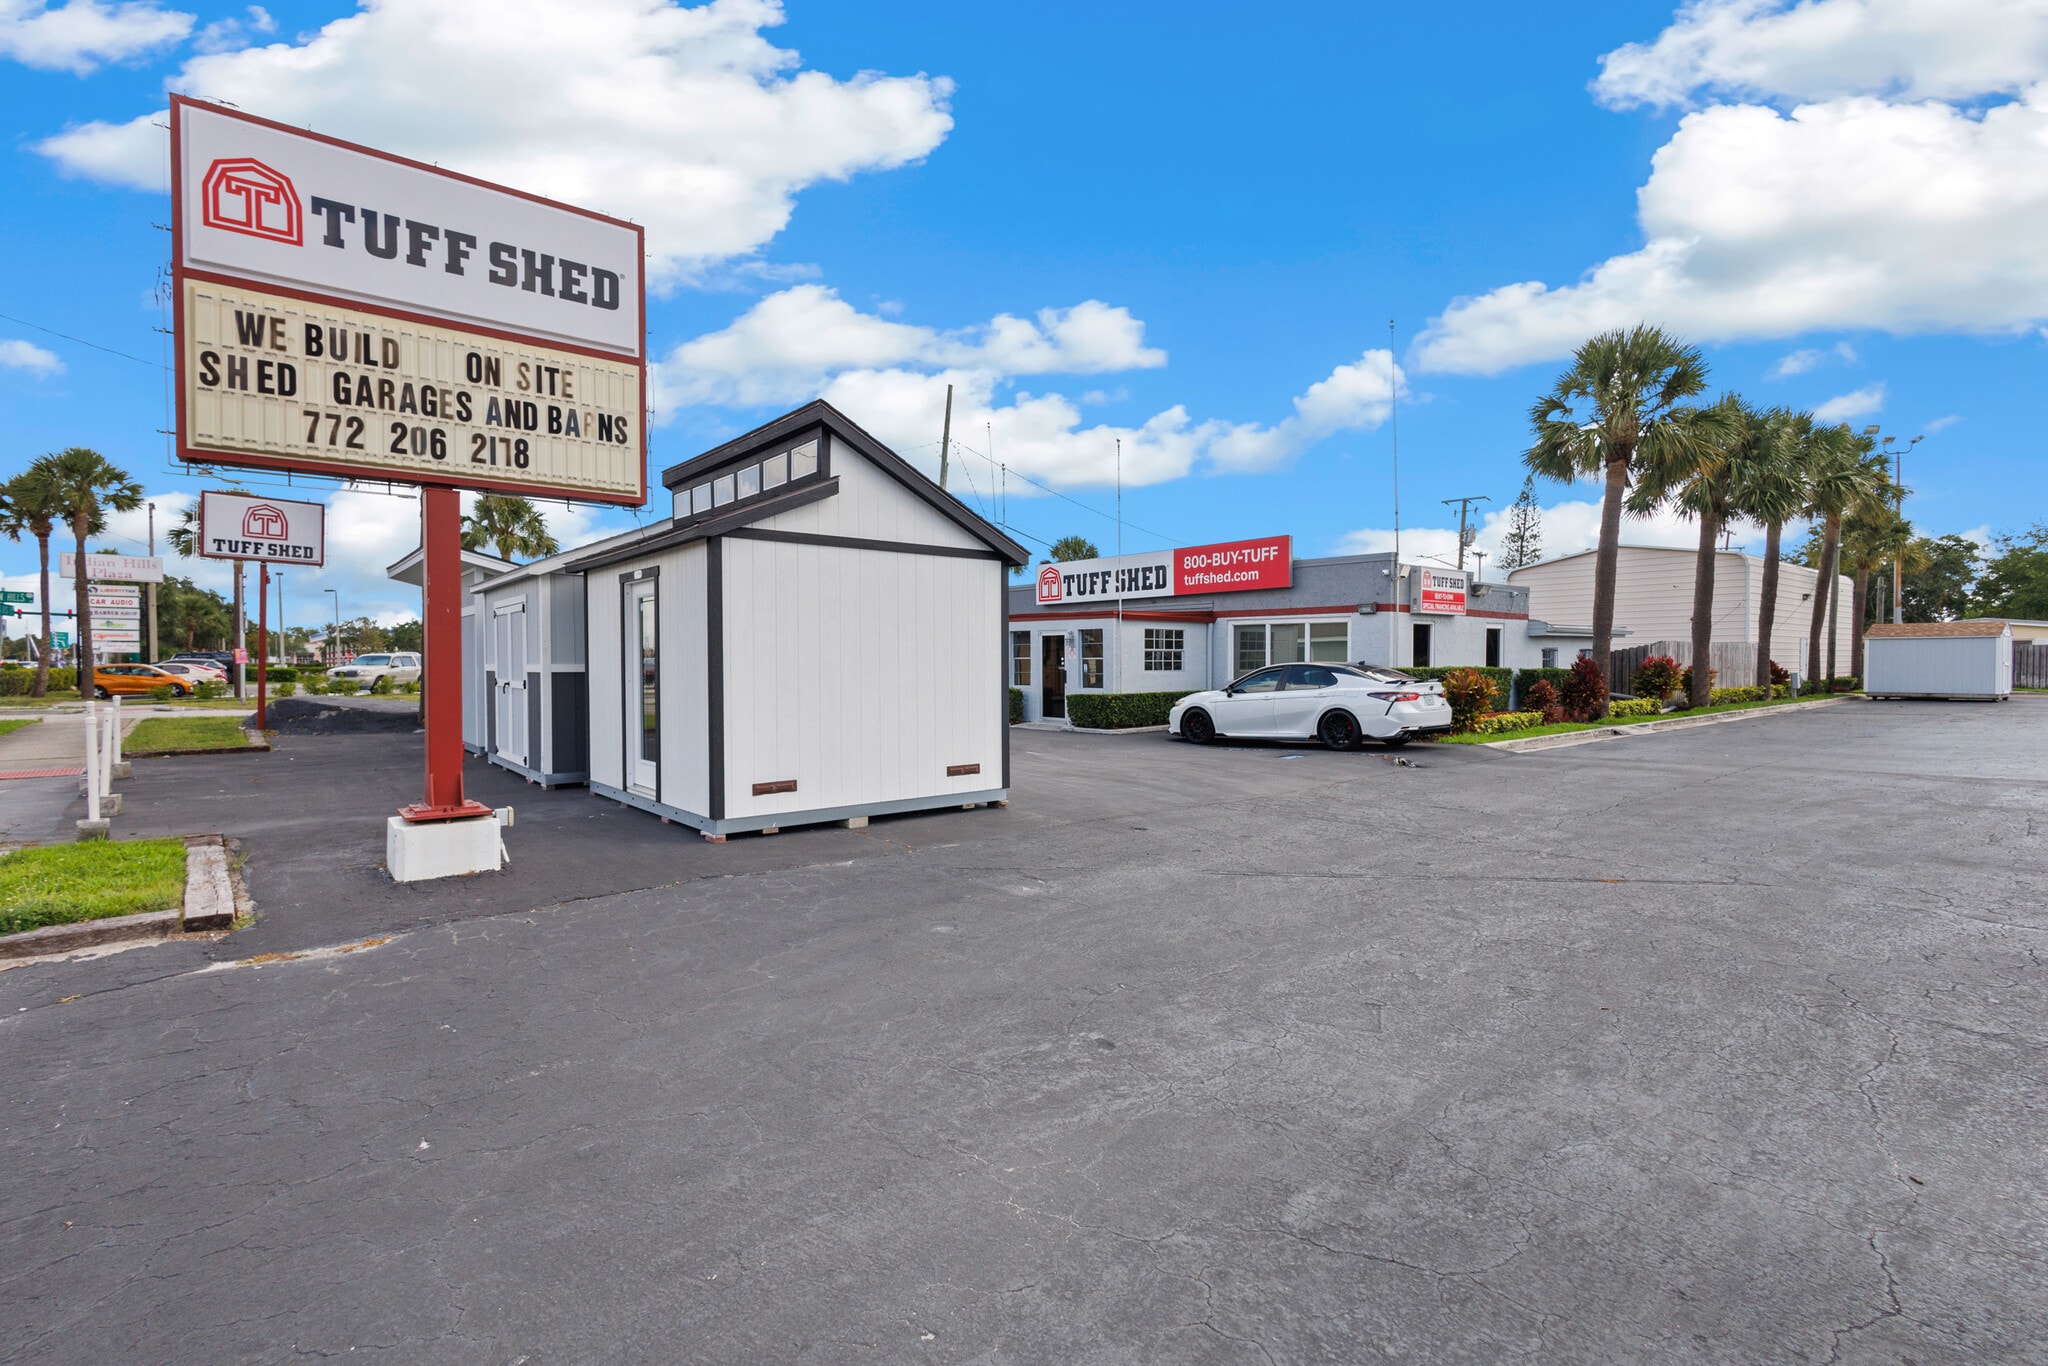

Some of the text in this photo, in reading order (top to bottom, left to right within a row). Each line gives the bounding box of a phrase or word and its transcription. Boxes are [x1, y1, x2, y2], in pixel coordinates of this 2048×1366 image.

[311, 195, 620, 311] TUFF SHED
[234, 310, 573, 398] WE BUILD ON SITE
[199, 350, 628, 444] SHED GARAGES AND BARNS
[303, 410, 529, 468] 772 206 2178
[213, 538, 314, 559] TUFF SHED
[1183, 546, 1278, 570] 800-BUY-TUFF
[65, 555, 158, 569] Idian Hills
[92, 567, 133, 579] Plaza
[1063, 564, 1168, 596] TUFF SHED
[1184, 569, 1259, 586] tuffshed.com
[1432, 576, 1464, 589] TUFF SHED
[6, 592, 26, 602] HILLS
